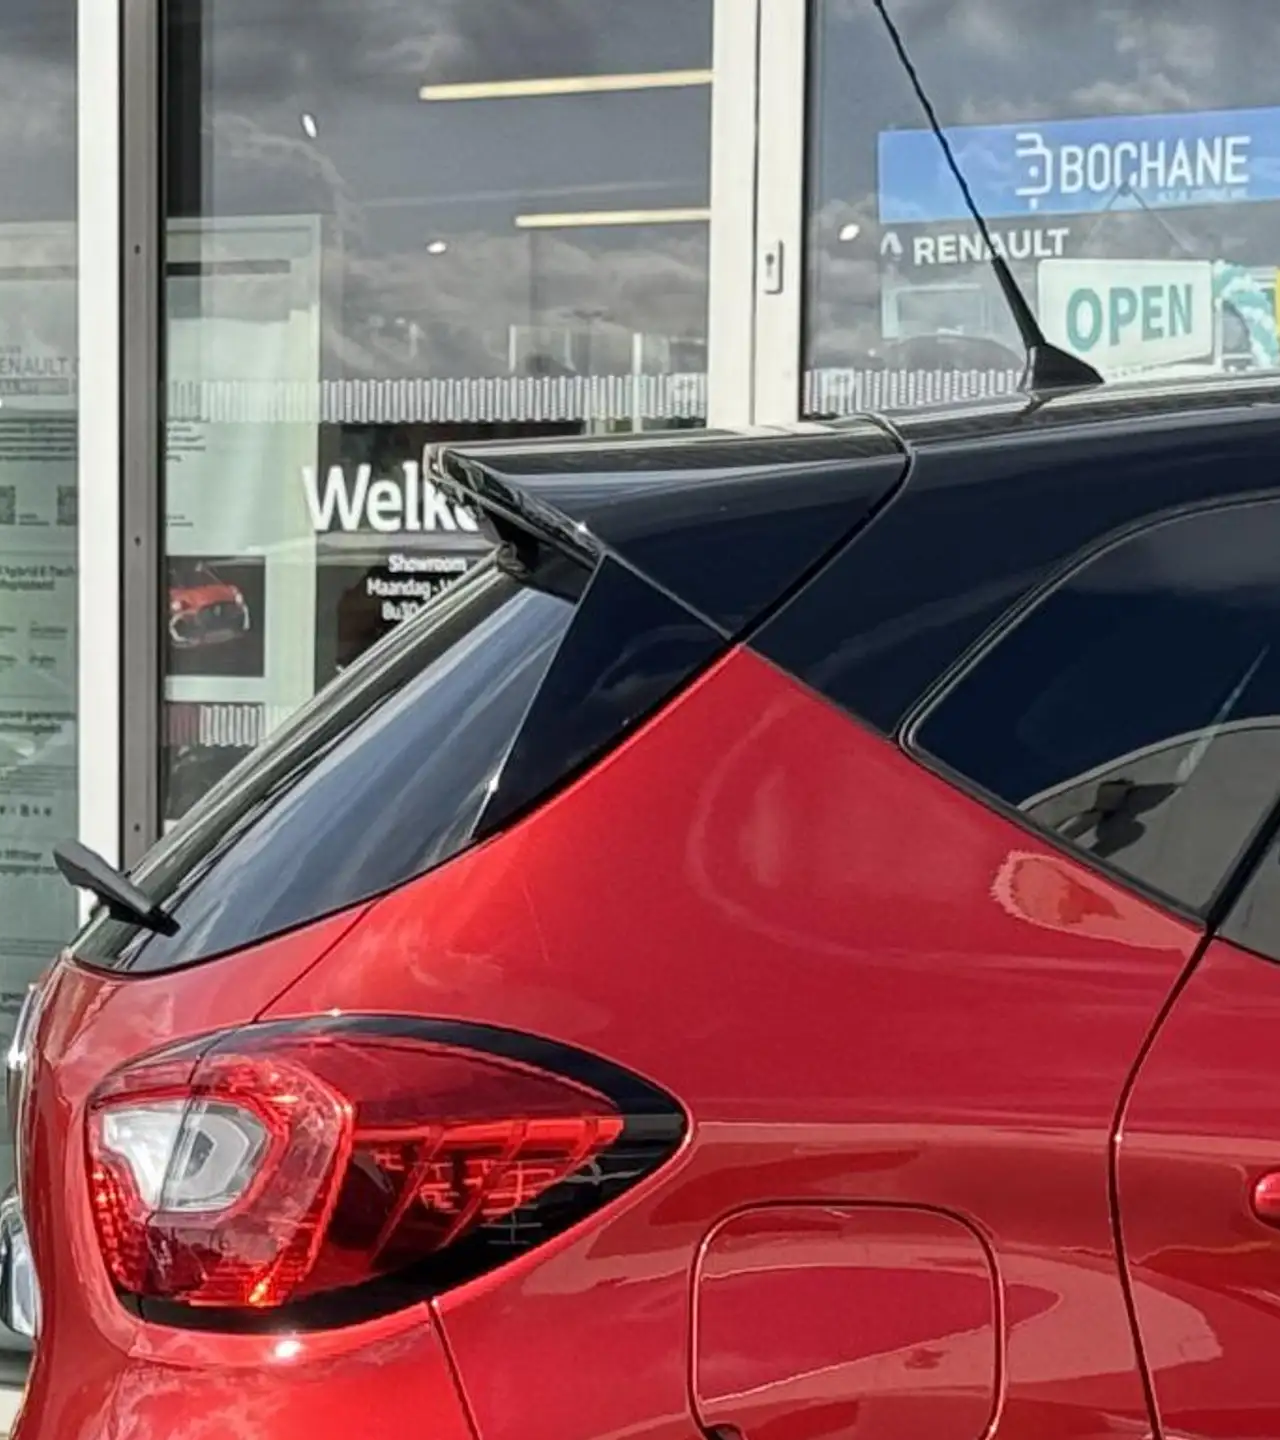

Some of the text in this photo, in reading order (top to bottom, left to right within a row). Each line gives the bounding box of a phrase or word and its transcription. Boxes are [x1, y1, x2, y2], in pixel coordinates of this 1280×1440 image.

[1059, 136, 1252, 193] BOCHANE
[913, 228, 1069, 265] RENAULT
[1066, 284, 1193, 352] OPEN
[388, 553, 467, 573] Showroom
[367, 577, 431, 600] Maandag
